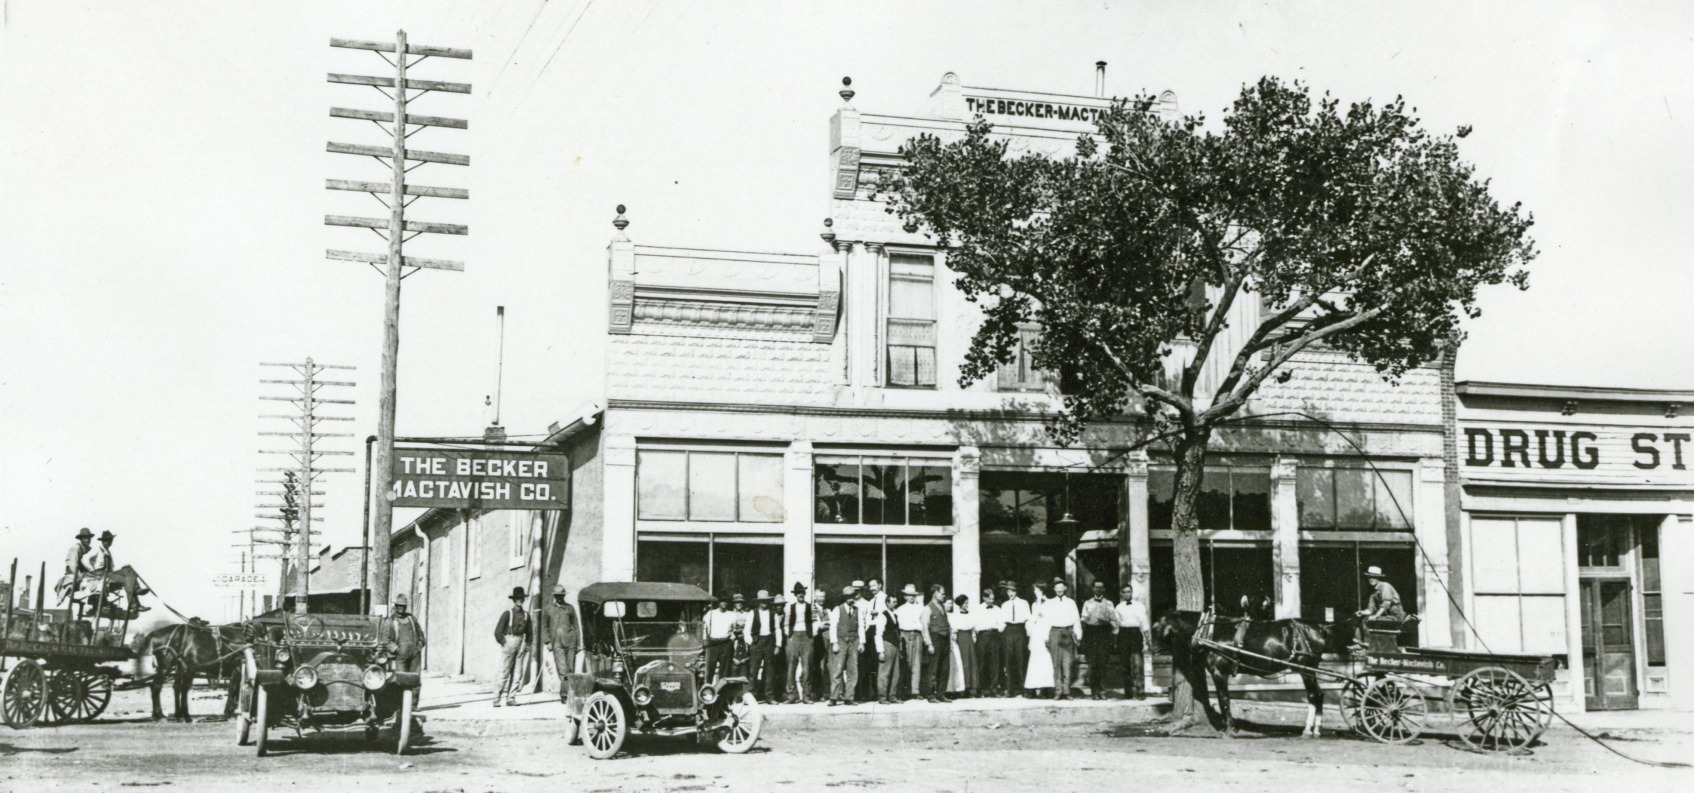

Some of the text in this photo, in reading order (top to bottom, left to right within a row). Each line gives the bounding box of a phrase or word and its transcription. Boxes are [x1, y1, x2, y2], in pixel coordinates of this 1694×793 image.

[966, 98, 995, 114] THE
[1464, 427, 1691, 471] DRUG ST
[400, 456, 548, 478] THE BECKER
[392, 480, 556, 501] MACTAVISH CO.
[1366, 655, 1378, 665] The
